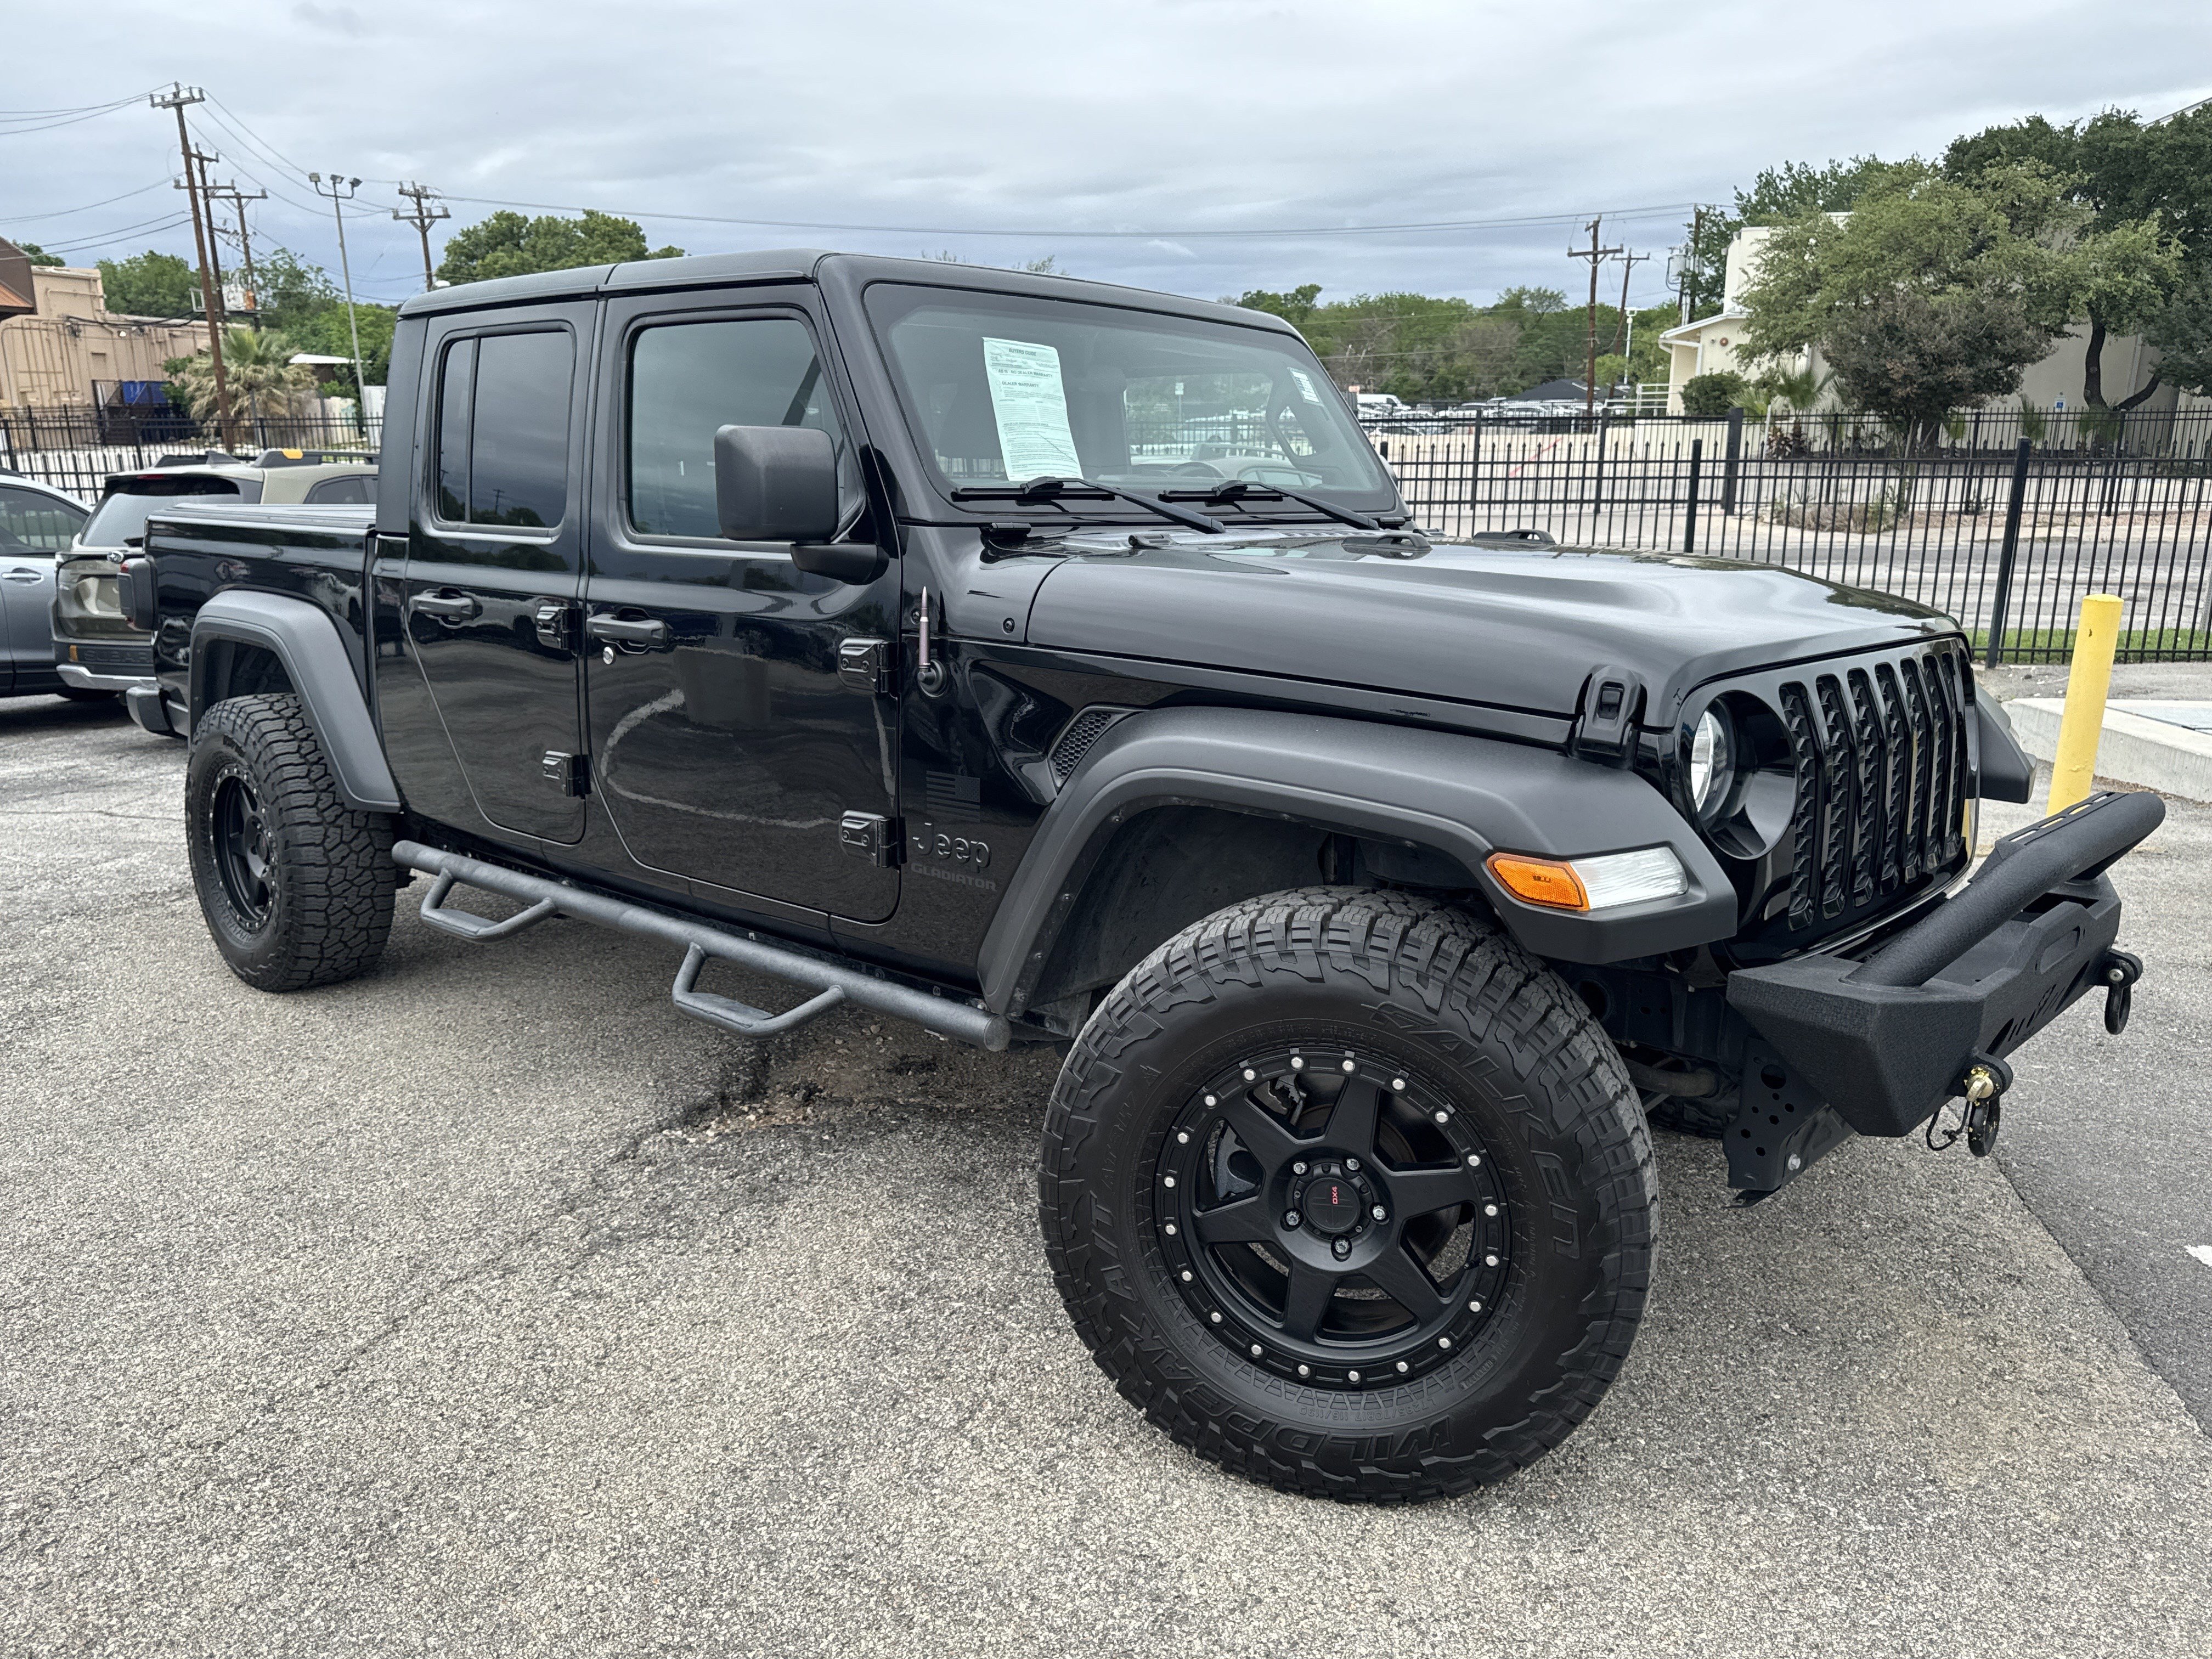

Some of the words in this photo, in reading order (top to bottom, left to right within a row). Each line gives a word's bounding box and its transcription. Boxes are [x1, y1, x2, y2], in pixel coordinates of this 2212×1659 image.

[84, 650, 153, 663] SUBAR
[912, 822, 992, 873] Jeep
[911, 862, 996, 891] GLADIATOR
[1361, 1001, 1581, 1260] FALKEN
[1119, 1312, 1452, 1463] WILDPEAK
[1354, 1397, 1436, 1422] LT285/70R17
